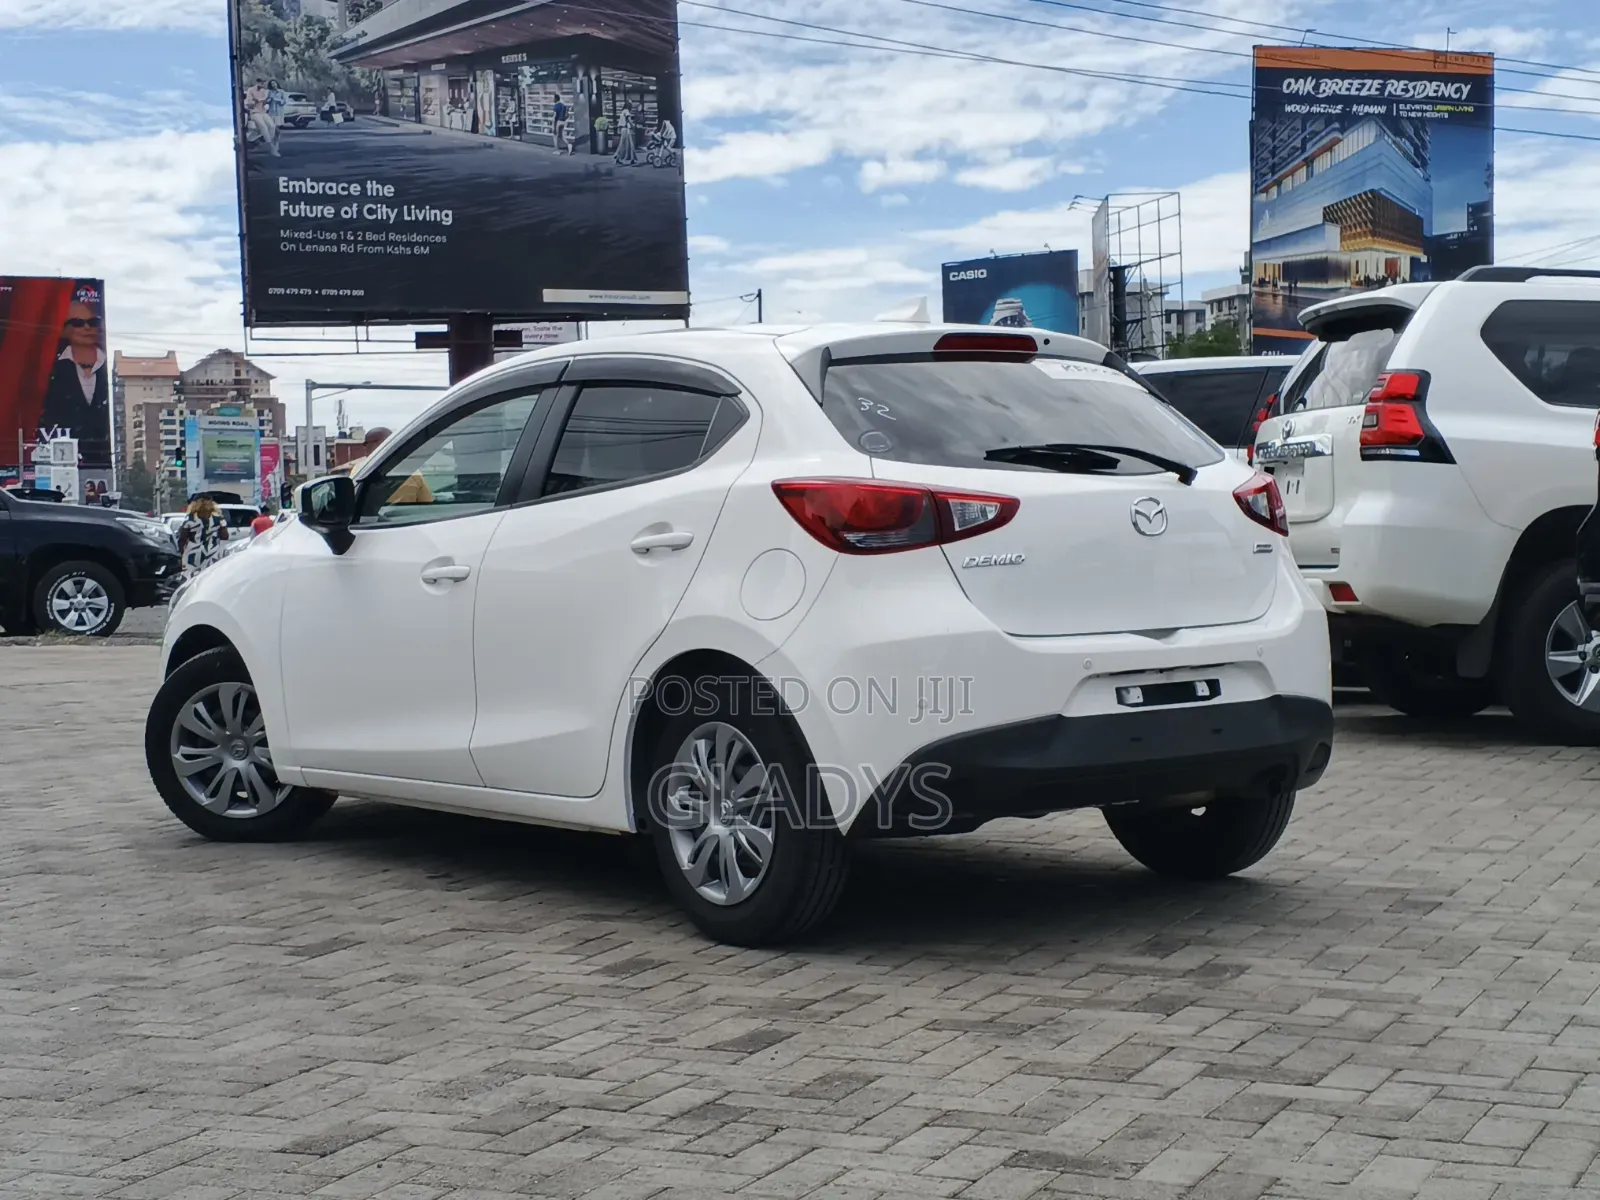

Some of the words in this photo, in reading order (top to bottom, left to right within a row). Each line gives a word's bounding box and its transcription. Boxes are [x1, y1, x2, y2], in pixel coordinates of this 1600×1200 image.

[1282, 76, 1316, 97] OAK
[1316, 78, 1385, 98] BREEZE
[278, 176, 362, 196] Embrace
[366, 180, 395, 197] the
[279, 200, 336, 219] Future
[340, 203, 359, 219] of
[363, 203, 398, 225] City
[403, 204, 453, 226] Living
[280, 229, 338, 240] Mixed-Use
[339, 231, 345, 240] 1
[346, 231, 354, 241] &
[356, 231, 364, 241] 2
[365, 231, 386, 242] Bed
[388, 232, 447, 243] Residences
[280, 241, 297, 252] On
[299, 242, 338, 253] Lenana
[340, 243, 355, 253] Rd
[357, 243, 385, 254] From
[386, 244, 412, 255] Kshs
[413, 245, 430, 255] 6M
[949, 268, 988, 281] CASIO
[961, 553, 1026, 569] DEMIO
